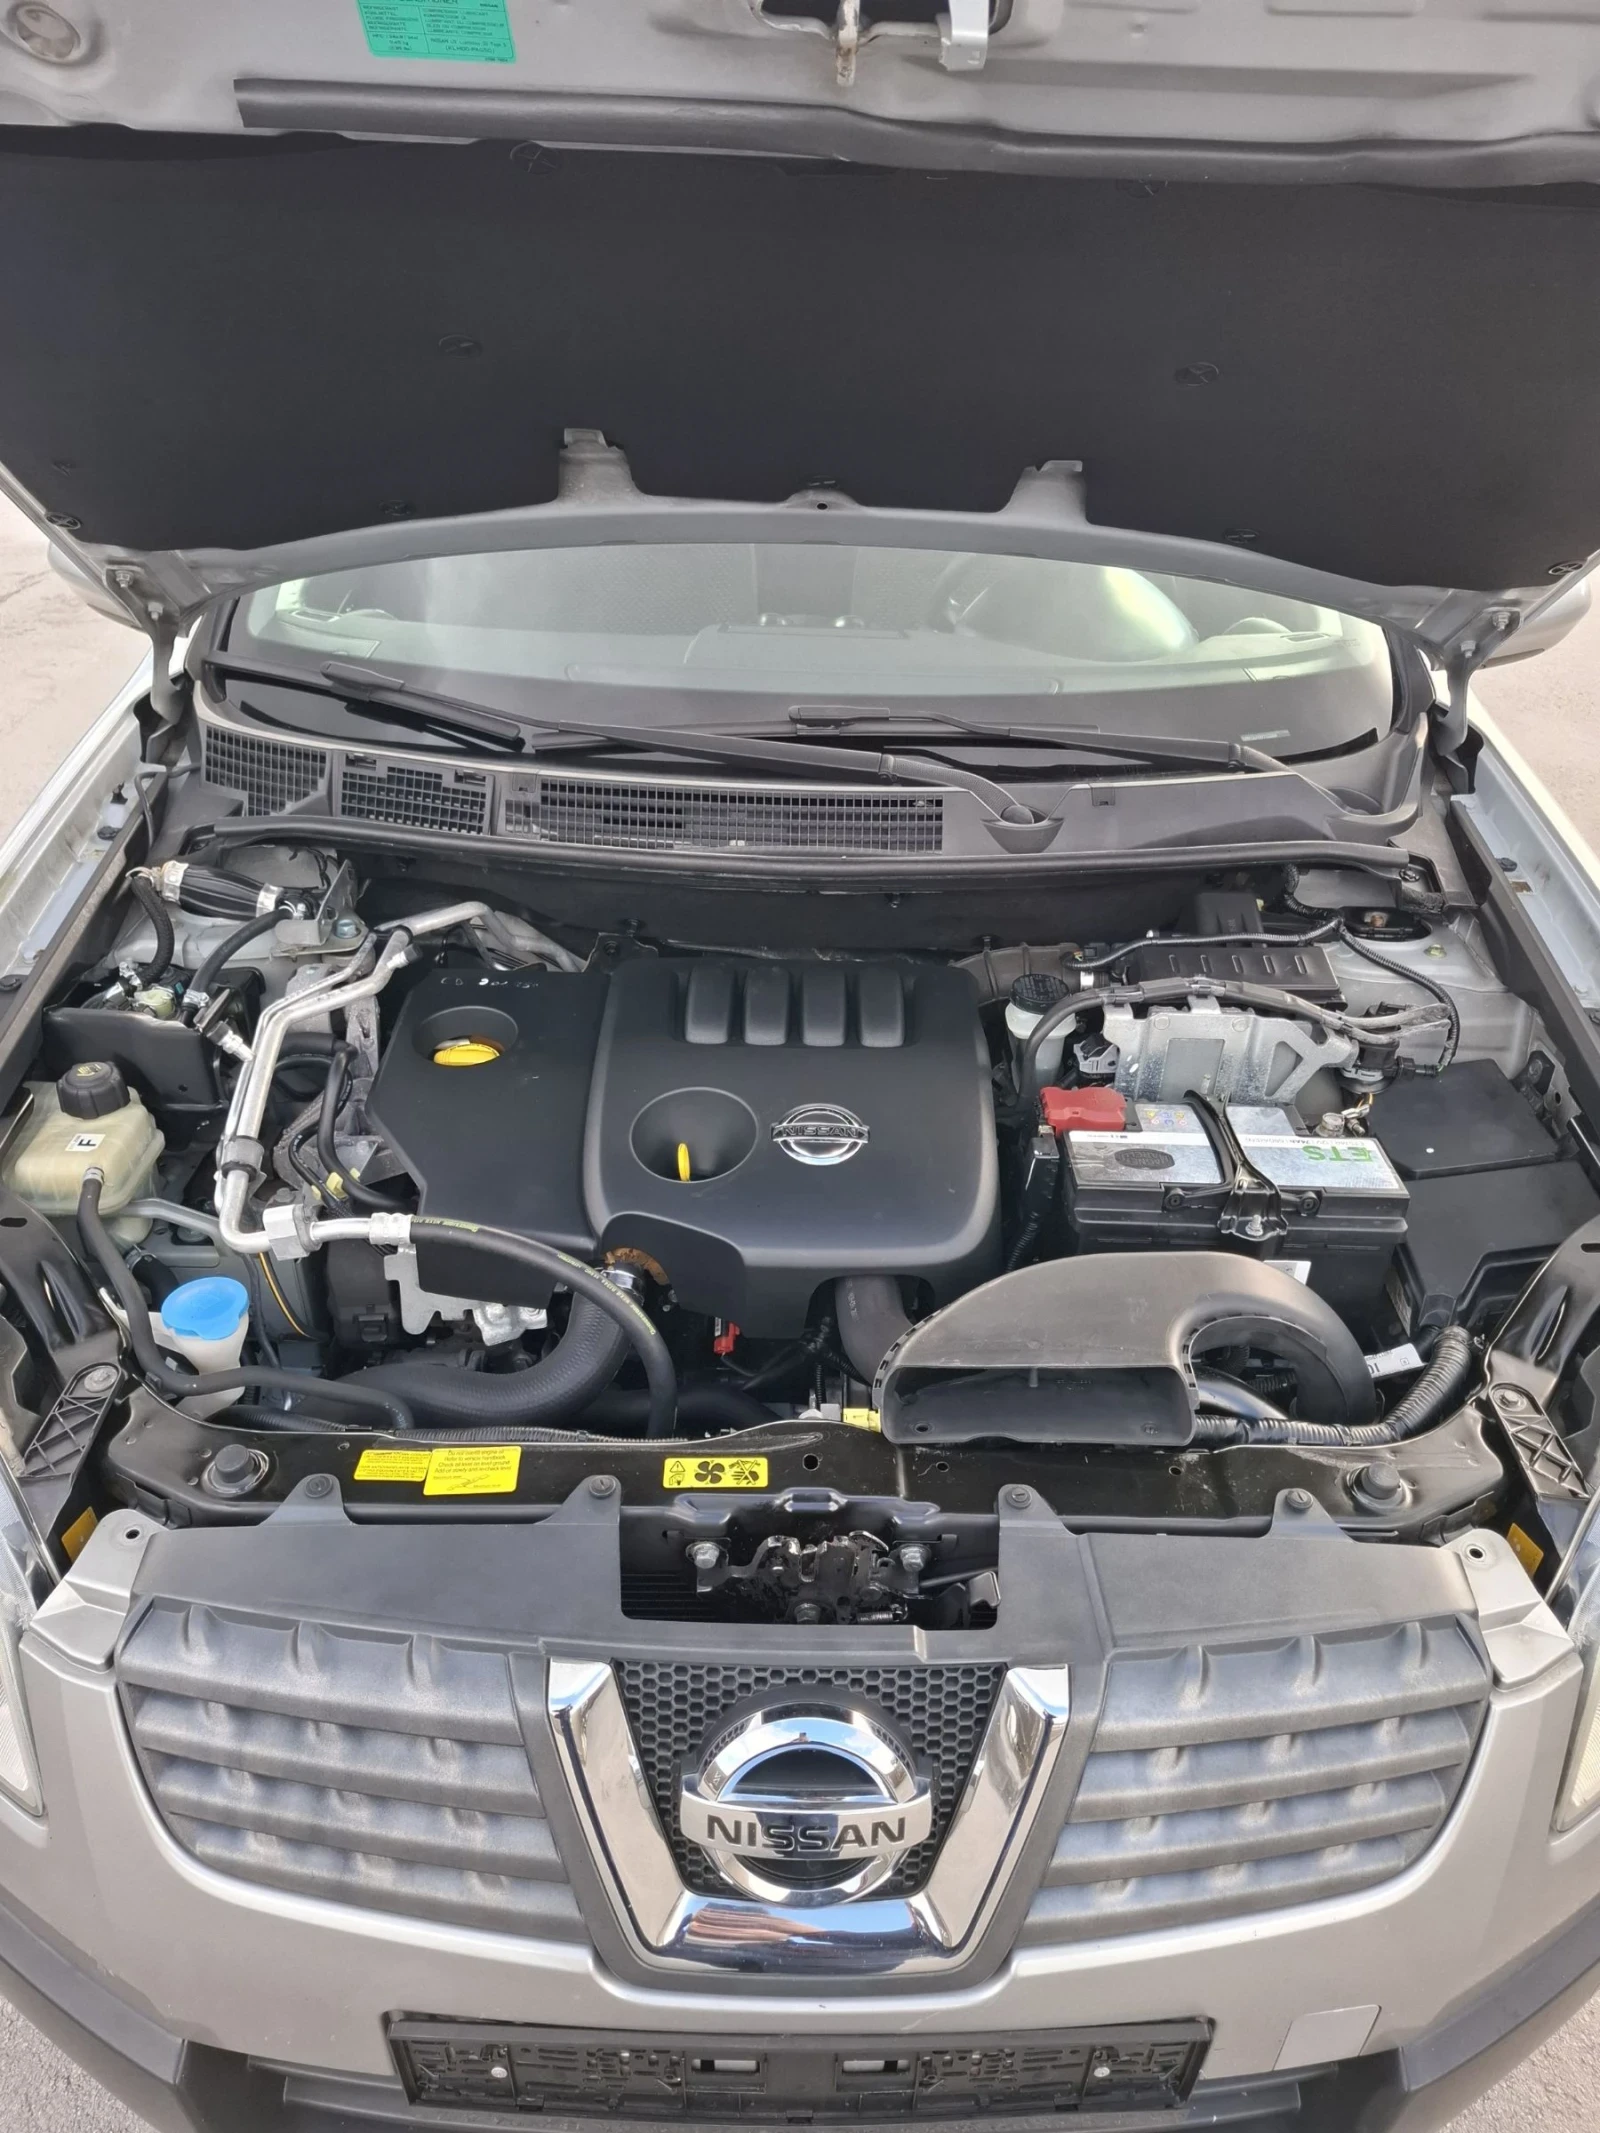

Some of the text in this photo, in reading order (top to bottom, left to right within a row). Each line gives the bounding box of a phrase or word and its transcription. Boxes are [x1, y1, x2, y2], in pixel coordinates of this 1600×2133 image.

[783, 1126, 858, 1138] NISSAN
[78, 1138, 96, 1147] F
[1302, 1145, 1372, 1161] ETS
[706, 1814, 906, 1852] NISSAN
